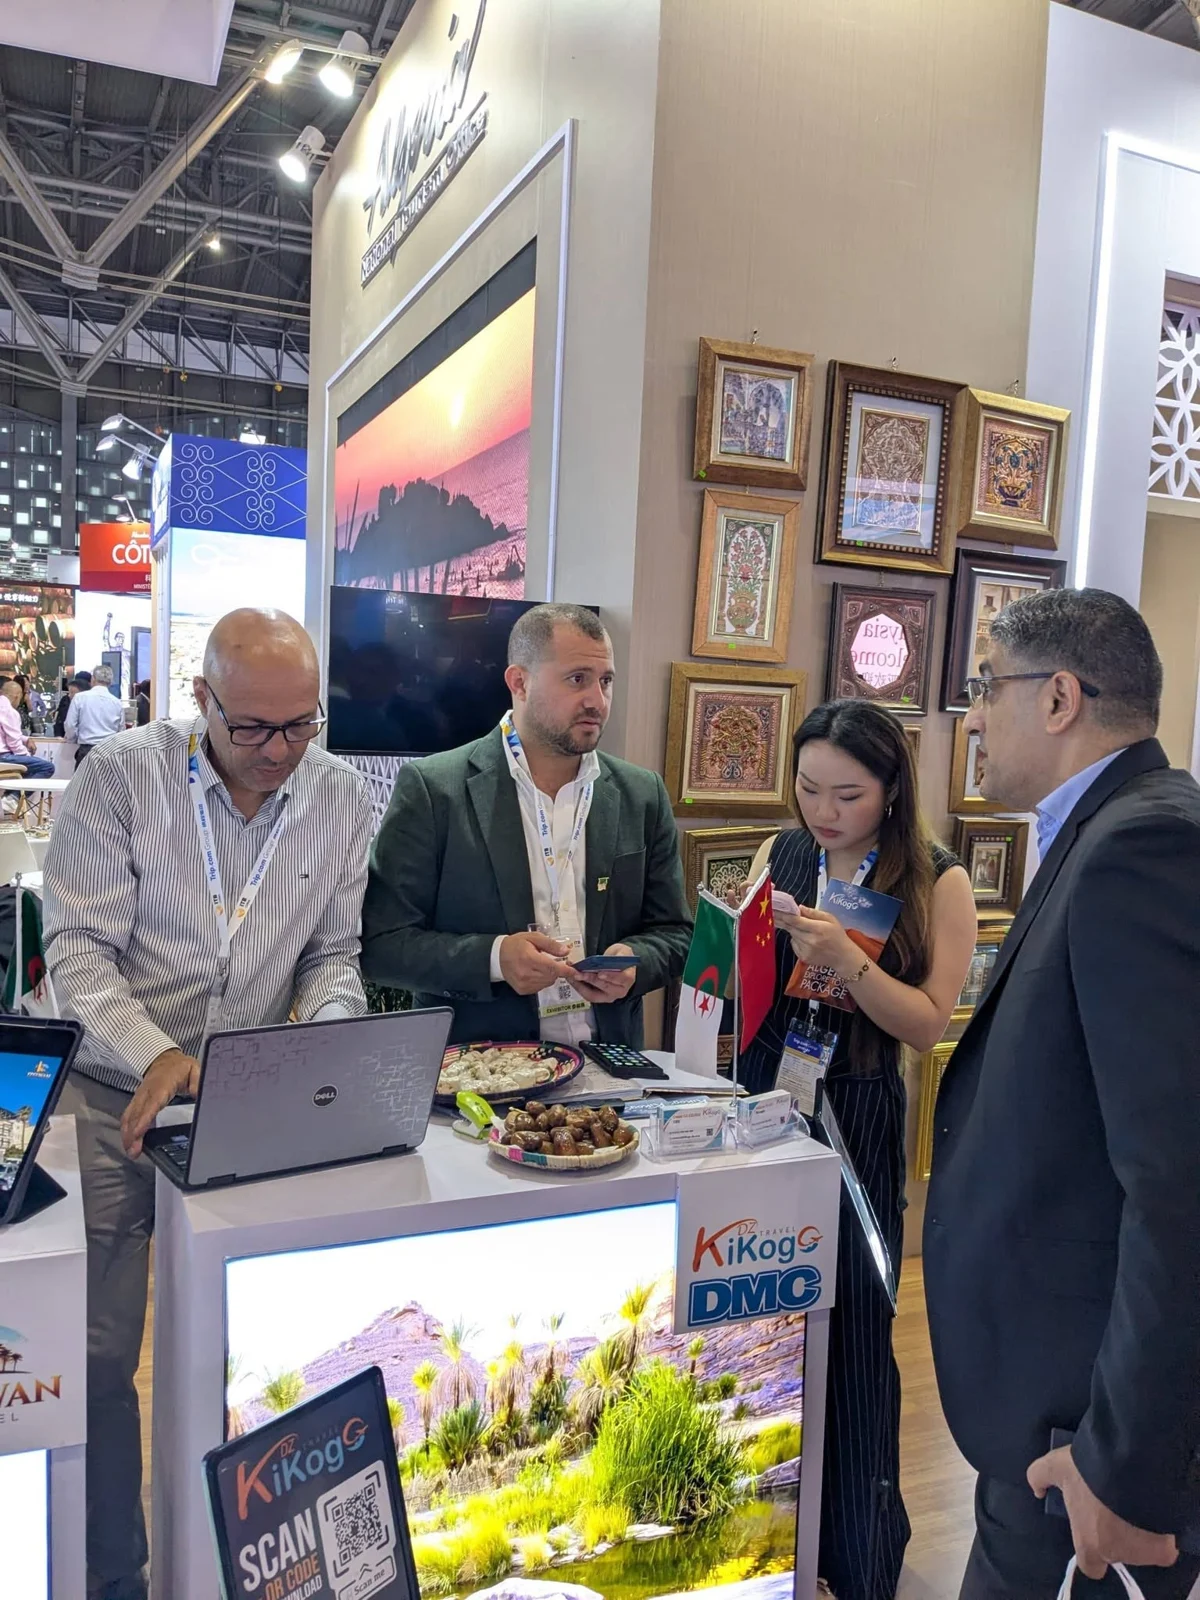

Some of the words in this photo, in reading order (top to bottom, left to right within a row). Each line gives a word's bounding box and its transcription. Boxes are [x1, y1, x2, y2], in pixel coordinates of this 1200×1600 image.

[361, 215, 398, 284] National
[399, 164, 446, 230] Tourism
[445, 108, 488, 172] Office
[539, 810, 548, 837] Trip.com
[203, 830, 211, 851] Group
[207, 851, 217, 882] Trip.com
[250, 859, 267, 886] Trip.com
[799, 979, 848, 1000] PACKAGE
[804, 971, 830, 983] EXPLORE
[314, 1091, 335, 1101] DELL
[737, 1222, 757, 1236] DZ
[759, 1226, 797, 1237] TRAVEL
[688, 1265, 822, 1327] DMC
[280, 1438, 296, 1458] DZ
[239, 1507, 316, 1592] SCAN
[286, 1551, 321, 1591] CODE
[354, 1578, 373, 1596] Scan
[374, 1569, 385, 1581] me
